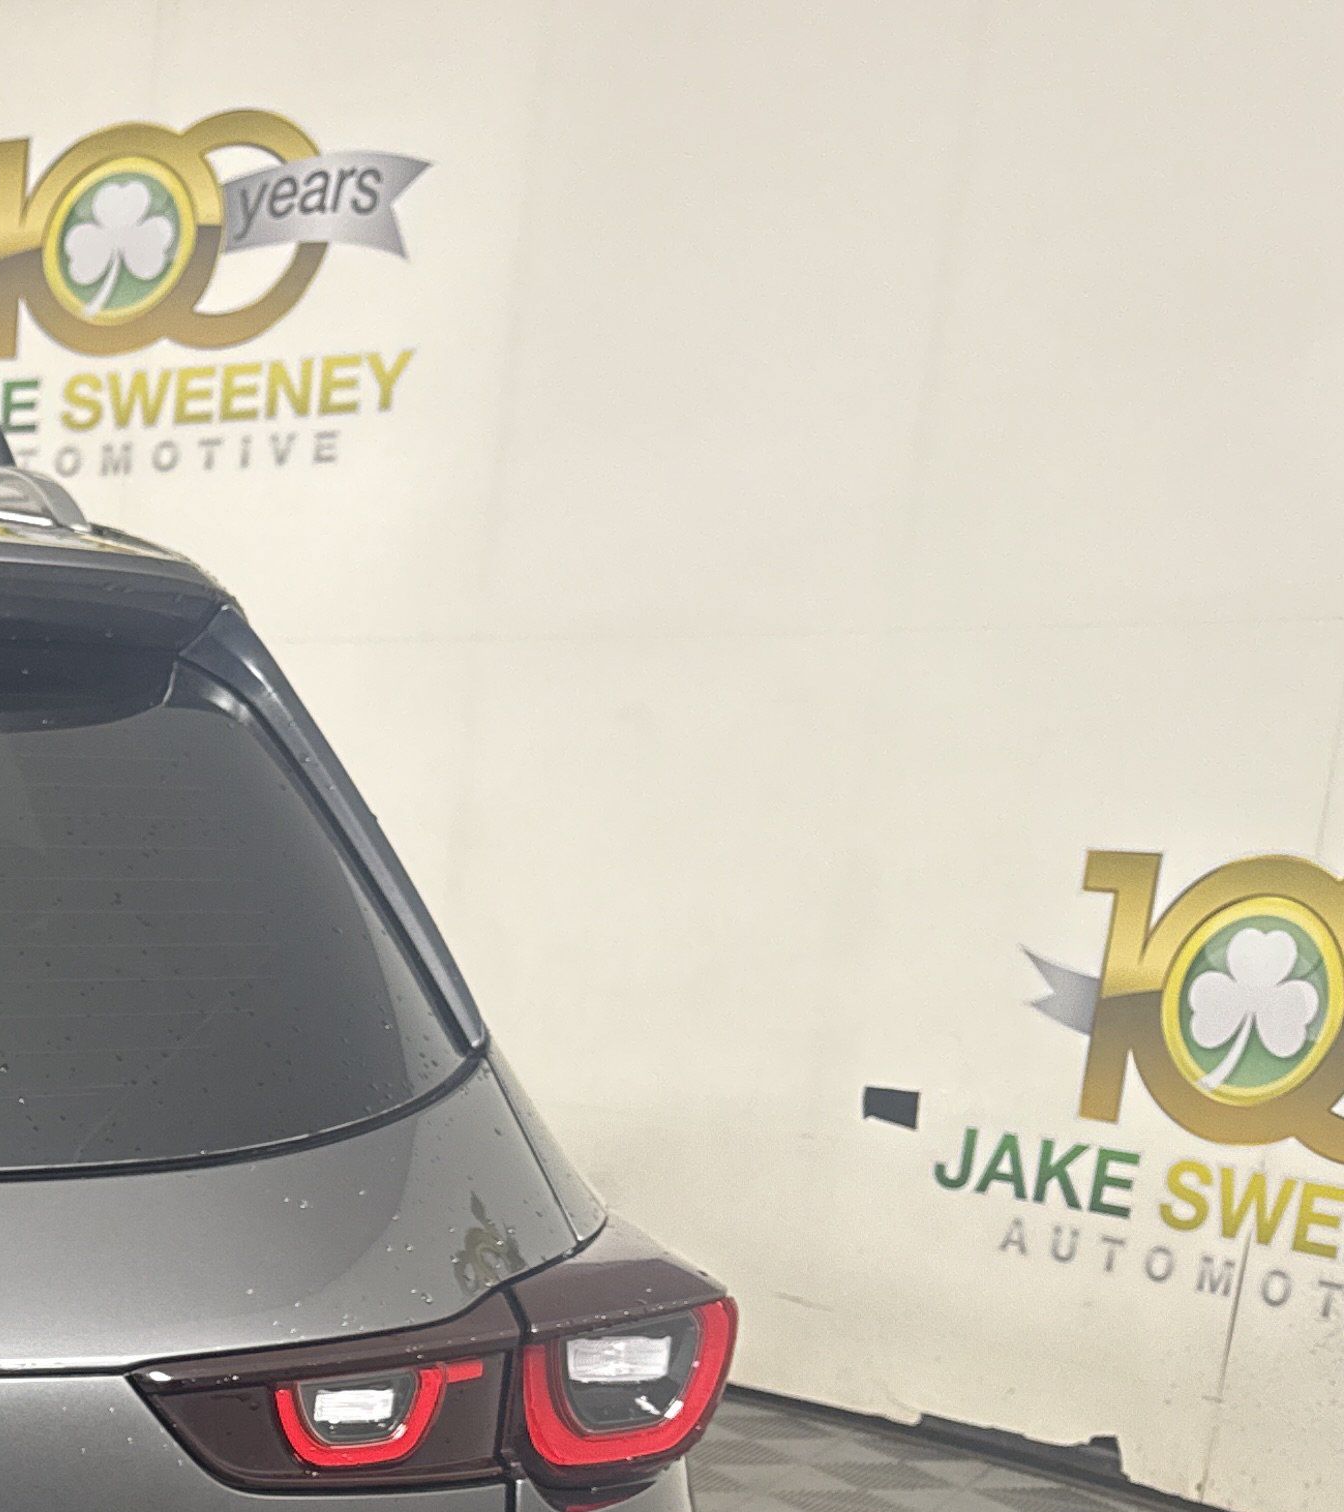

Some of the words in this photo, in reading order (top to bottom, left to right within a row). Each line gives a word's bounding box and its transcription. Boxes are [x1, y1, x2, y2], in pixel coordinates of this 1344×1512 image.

[237, 161, 385, 238] years
[60, 349, 415, 431] SWEENEY
[934, 1127, 1141, 1220] JAKE
